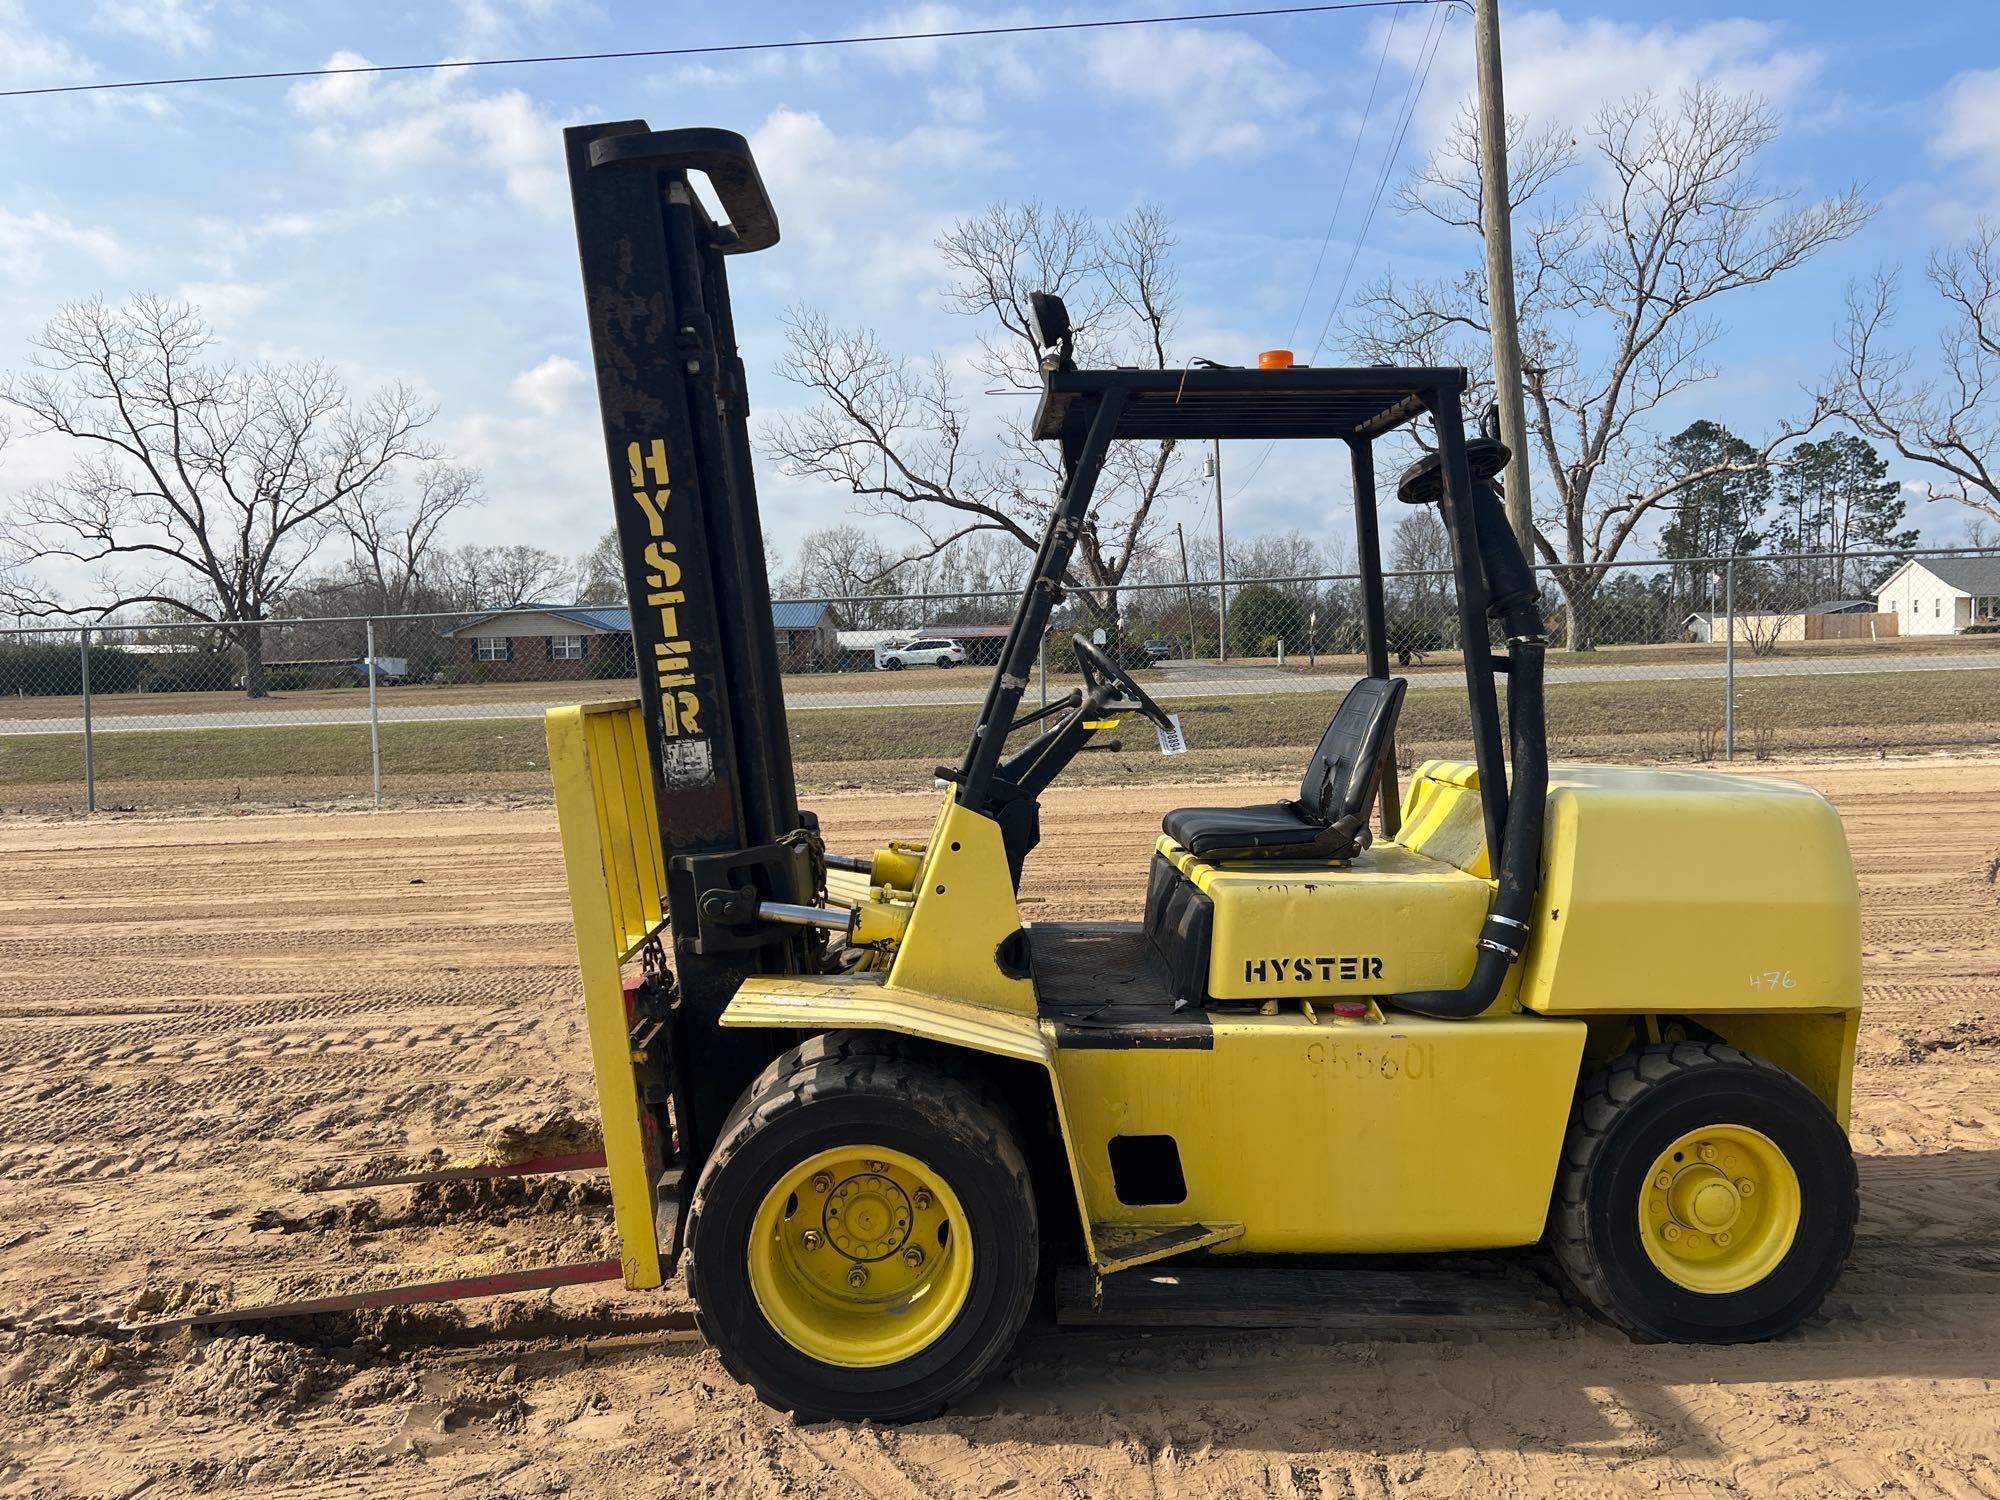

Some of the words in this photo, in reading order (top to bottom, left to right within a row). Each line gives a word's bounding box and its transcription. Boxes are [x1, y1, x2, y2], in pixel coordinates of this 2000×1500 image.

[627, 439, 703, 736] HYSTER
[1244, 956, 1384, 983] HYSTER
[1749, 970, 1797, 992] 476
